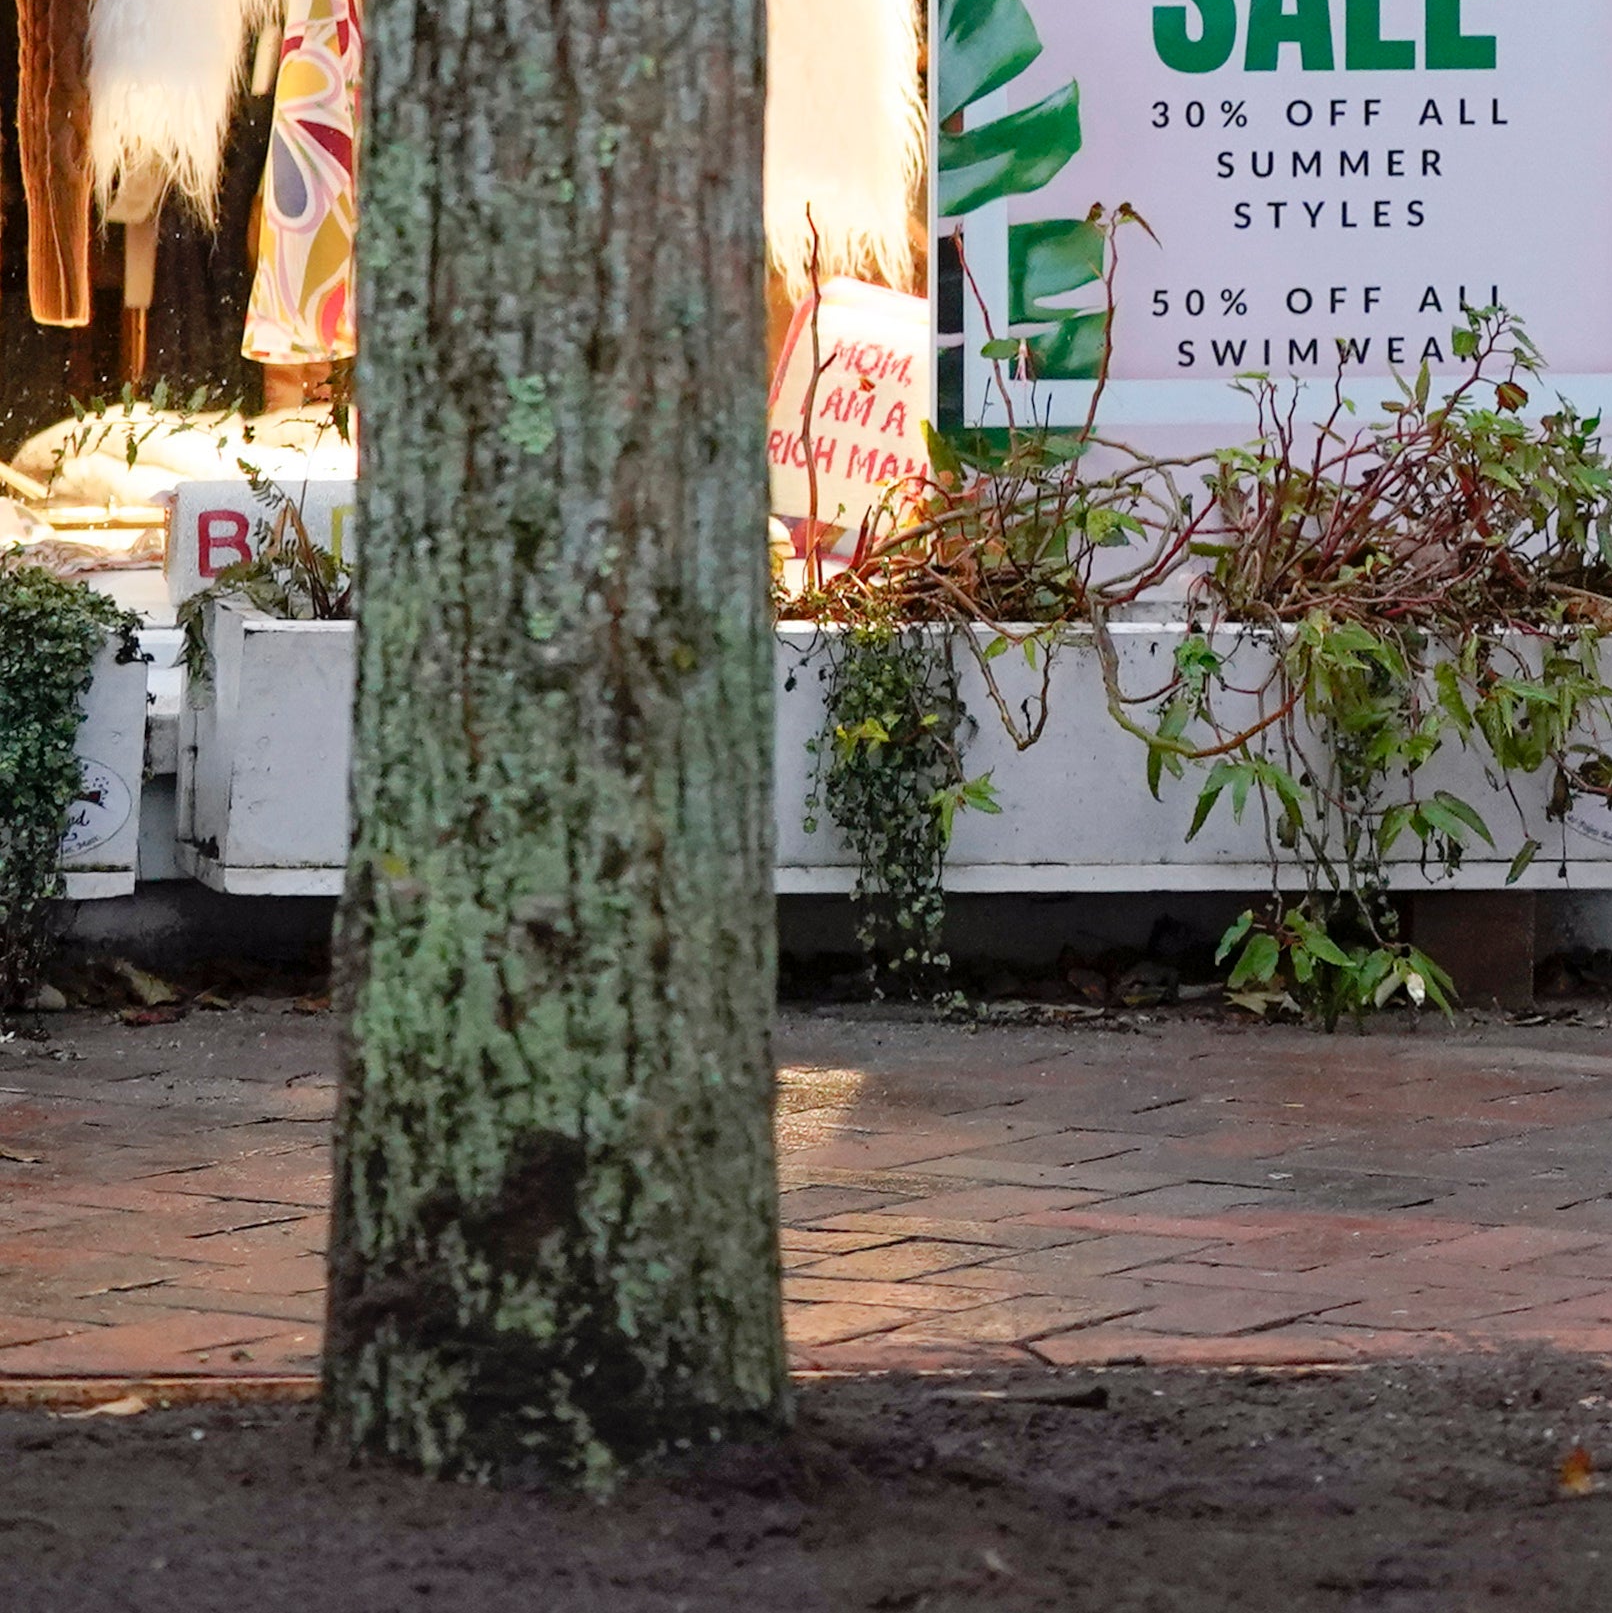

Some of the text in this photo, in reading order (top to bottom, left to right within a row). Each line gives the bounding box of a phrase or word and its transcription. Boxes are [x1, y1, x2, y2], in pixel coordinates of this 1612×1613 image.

[1151, 98, 1509, 128] 30% OFF ALL
[1216, 150, 1444, 178] SUMMER
[1233, 200, 1426, 229] STYLES
[1151, 288, 1249, 317] 50%
[1285, 287, 1382, 315] OFF
[833, 339, 913, 387] MOM,
[1177, 336, 1479, 367] SWIMWEA
[819, 386, 876, 427] AM
[880, 400, 906, 437] A
[767, 429, 837, 474] RICH
